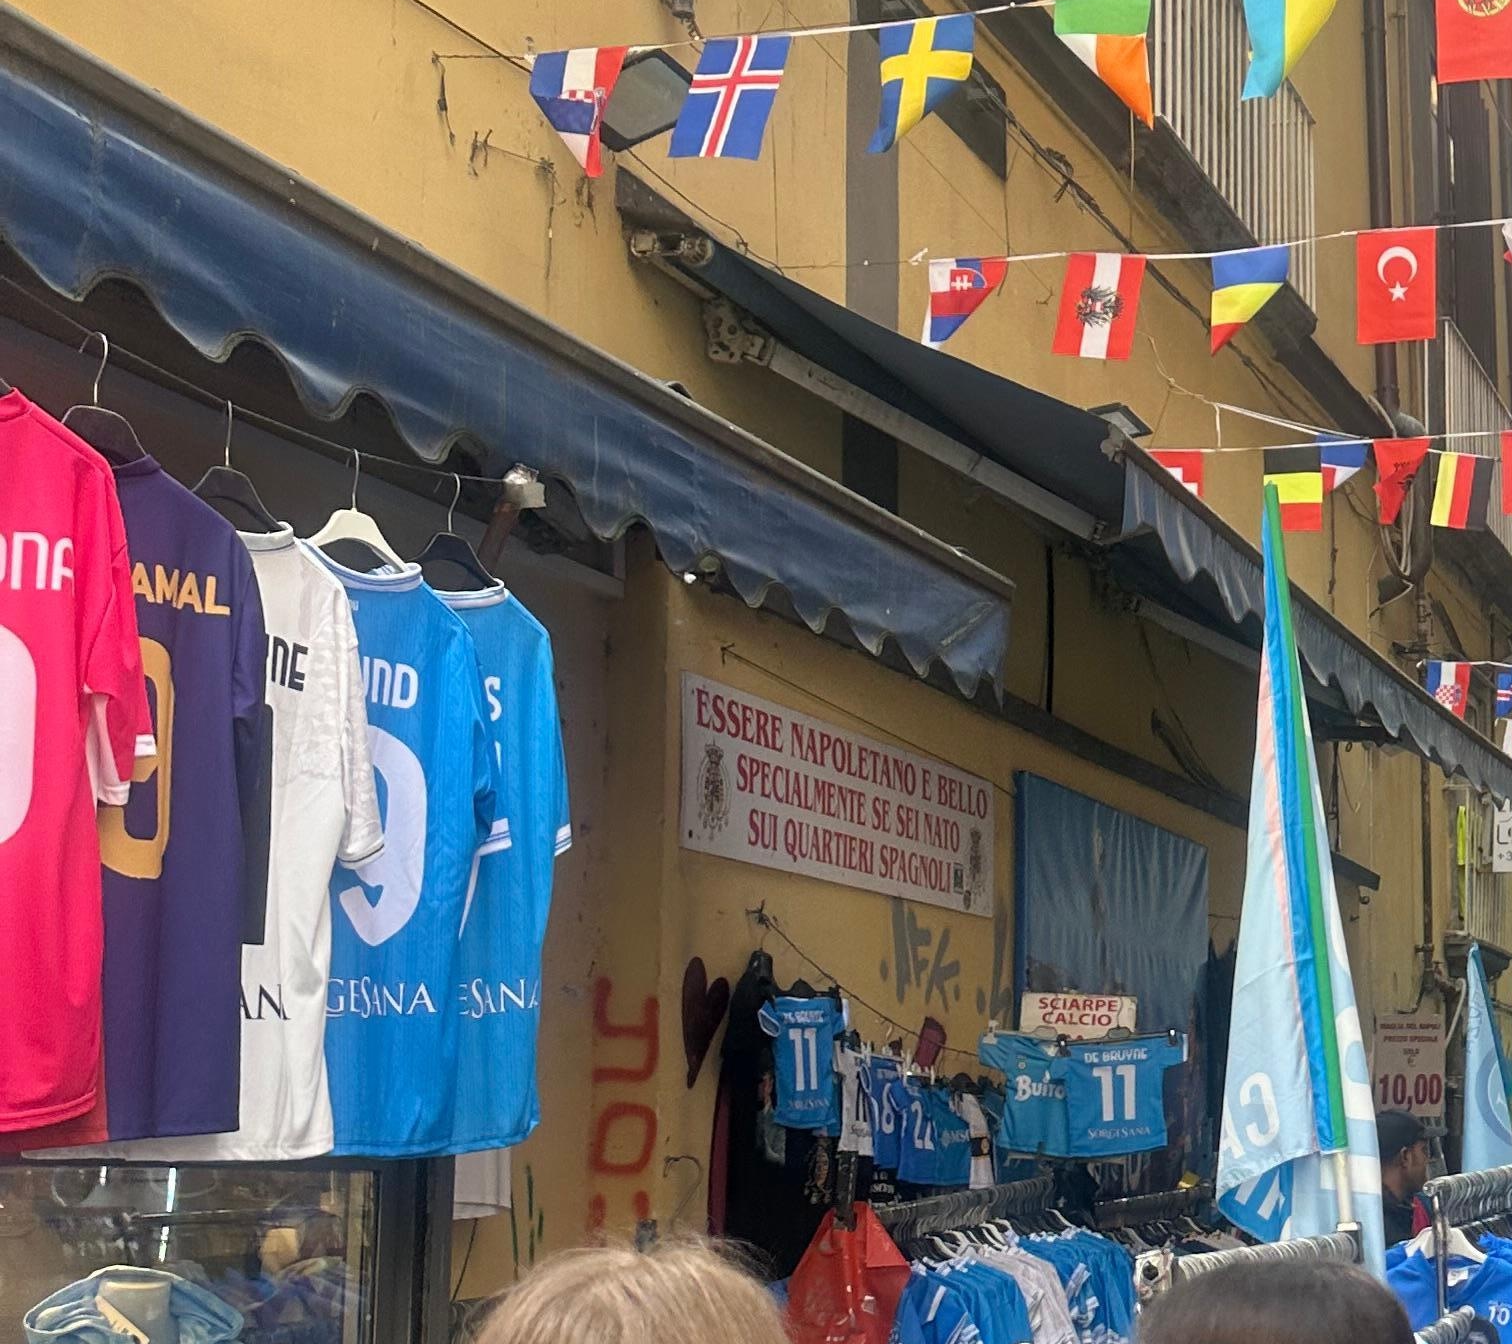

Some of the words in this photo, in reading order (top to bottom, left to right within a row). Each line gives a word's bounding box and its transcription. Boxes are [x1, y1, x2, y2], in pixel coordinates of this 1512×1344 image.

[132, 562, 230, 615] AMAL
[694, 685, 784, 753] ESSERE
[791, 722, 916, 797] NAPOLETANO
[921, 767, 932, 802] E
[937, 775, 988, 820] BELLO
[736, 753, 866, 826] SPECIALMENTE
[872, 797, 891, 834] SE
[897, 804, 920, 842] SEI
[923, 812, 960, 853] NATO
[748, 808, 778, 851] SUI
[784, 818, 875, 875] QUARTIERI
[879, 844, 951, 894] SPAGNOLI
[1039, 997, 1118, 1012] SCIARPE
[1042, 1013, 1112, 1026] CALCIO
[788, 1028, 818, 1091] 11
[1085, 1052, 1099, 1063] DE
[1102, 1048, 1148, 1062] BRUYNE
[1092, 1064, 1136, 1122] 11
[1379, 1073, 1442, 1112] 10,00
[1488, 1306, 1510, 1326] 10
